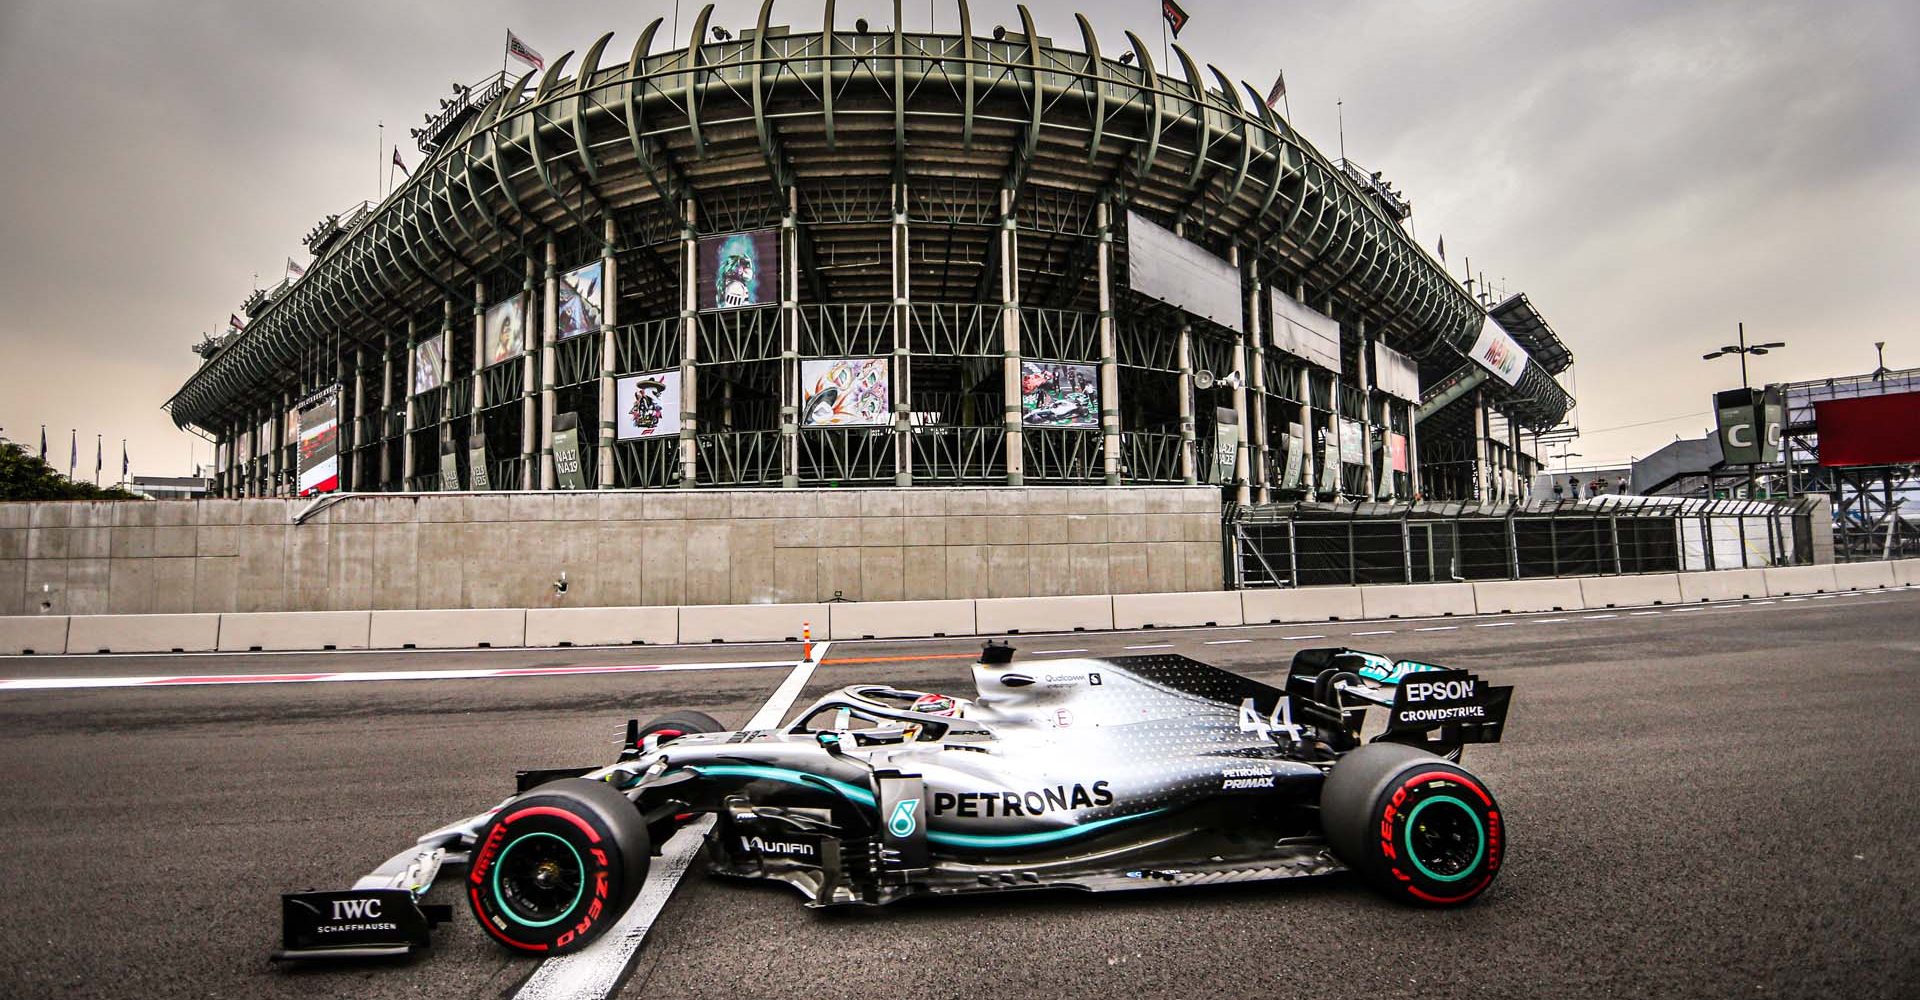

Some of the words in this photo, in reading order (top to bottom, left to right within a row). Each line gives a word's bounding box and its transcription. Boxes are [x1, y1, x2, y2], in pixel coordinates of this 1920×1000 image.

[1728, 424, 1752, 447] C
[556, 449, 576, 462] NA17
[558, 461, 578, 474] NA19
[1406, 680, 1475, 702] EPSON
[1239, 695, 1303, 741] 44
[1400, 706, 1485, 722] CROWDSTRIKE
[1222, 766, 1273, 778] PETRONAS
[1222, 776, 1275, 790] PRIMAX
[934, 780, 1114, 818] PETRONAS
[332, 898, 382, 920] IWC
[317, 923, 397, 933] SCHAFFHAUSEN
